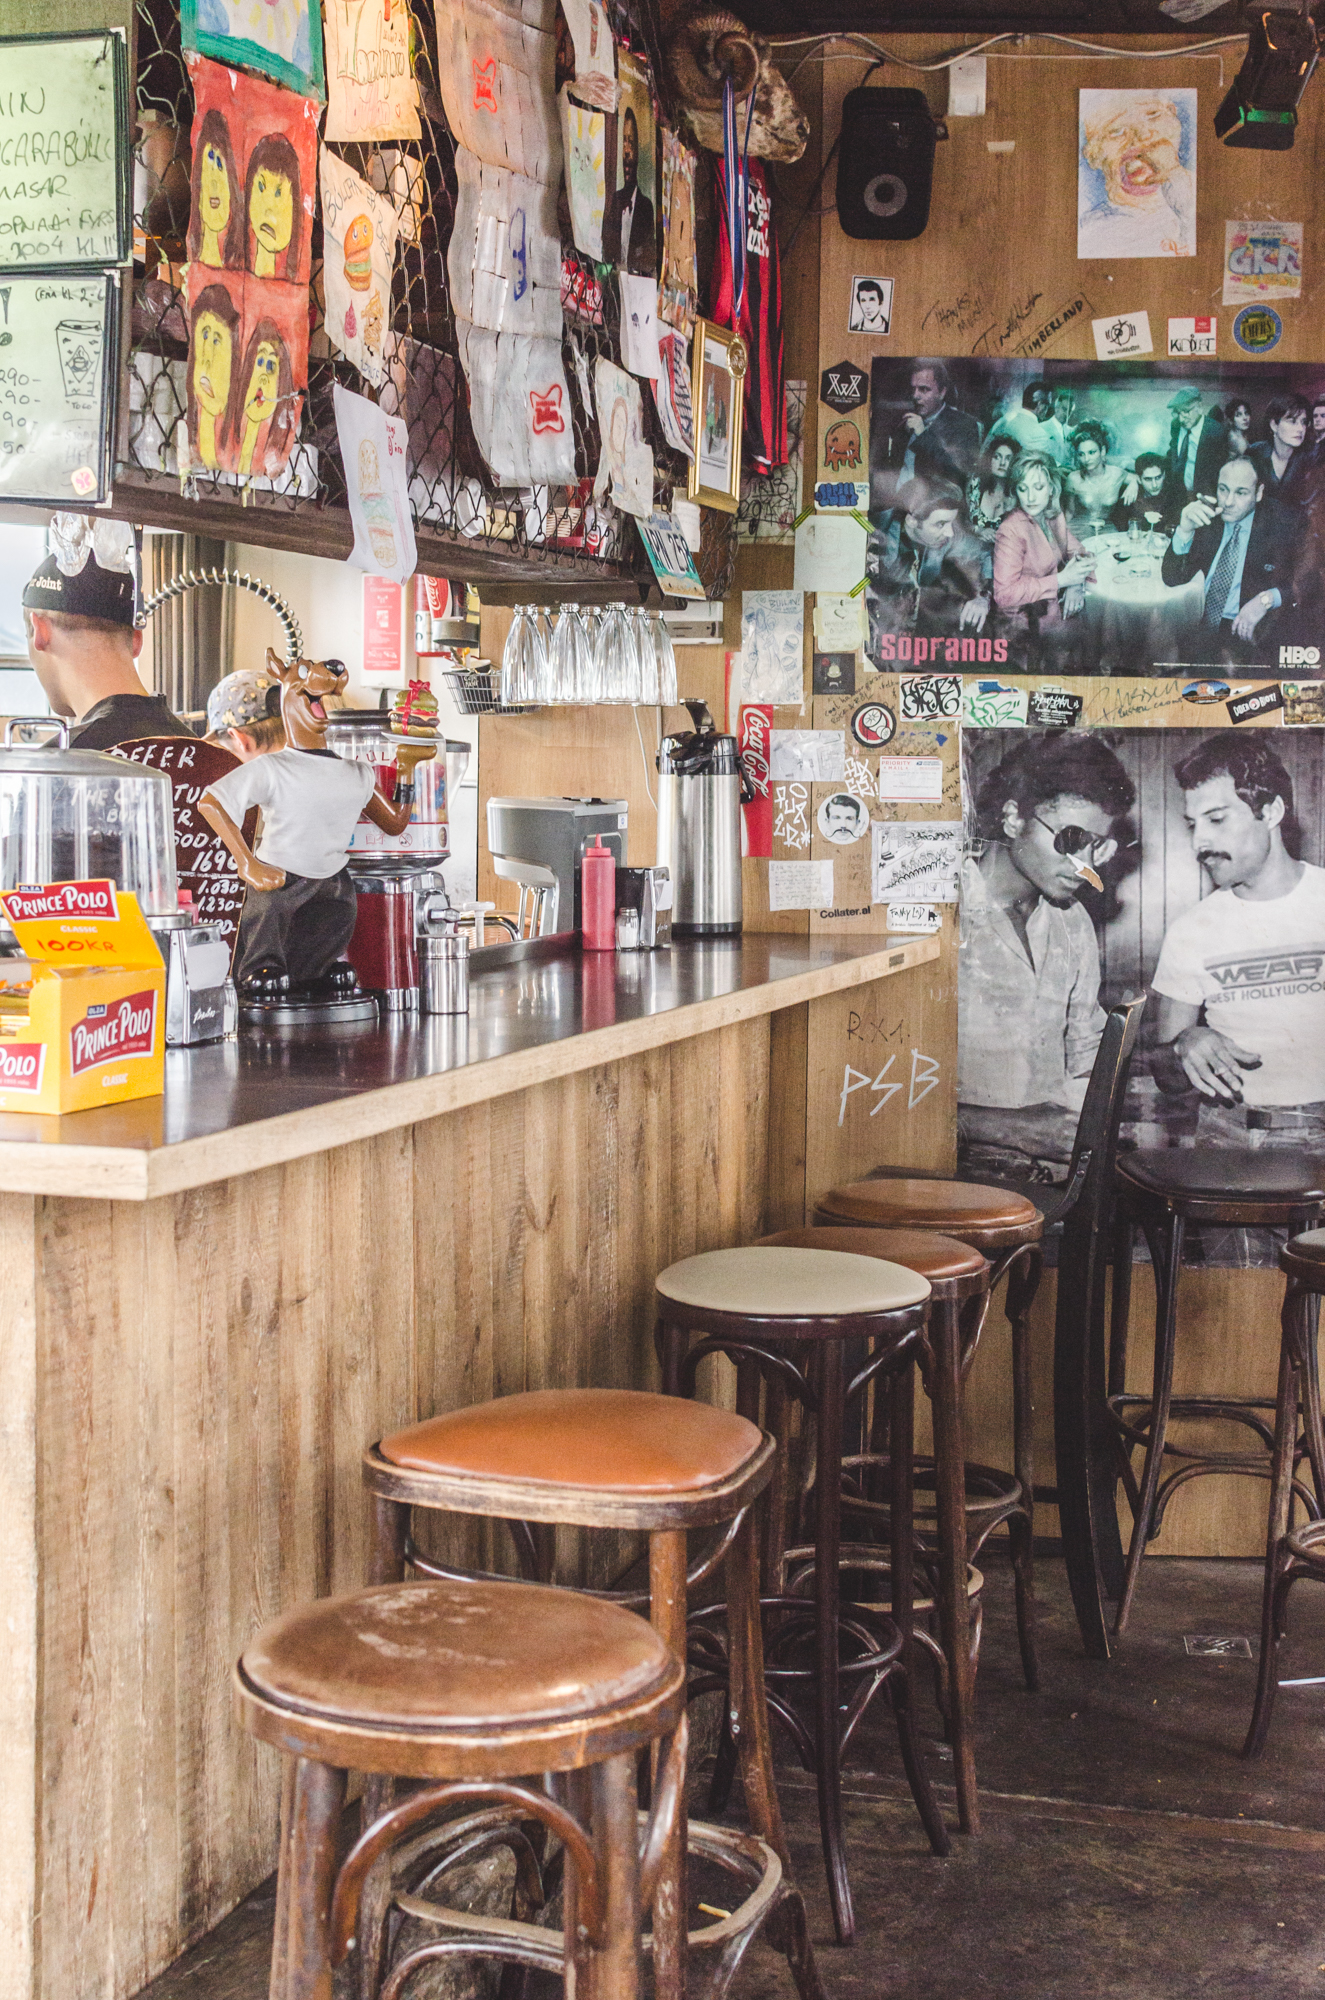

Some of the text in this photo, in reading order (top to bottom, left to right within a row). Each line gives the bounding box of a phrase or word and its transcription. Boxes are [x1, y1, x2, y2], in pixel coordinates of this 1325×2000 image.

[1016, 300, 1083, 357] TIMBERLAND
[36, 576, 62, 592] Joint
[881, 633, 1009, 666] Sopranos
[1279, 646, 1321, 665] HBO
[7, 885, 108, 918] PRINCE POLO
[820, 905, 871, 919] Collater.al
[60, 925, 98, 933] CLASSIC
[87, 1005, 105, 1016] OLZA
[73, 1001, 151, 1066] PRINCE POLO
[102, 1073, 128, 1088] CLASSIC
[837, 1048, 940, 1127] PSB
